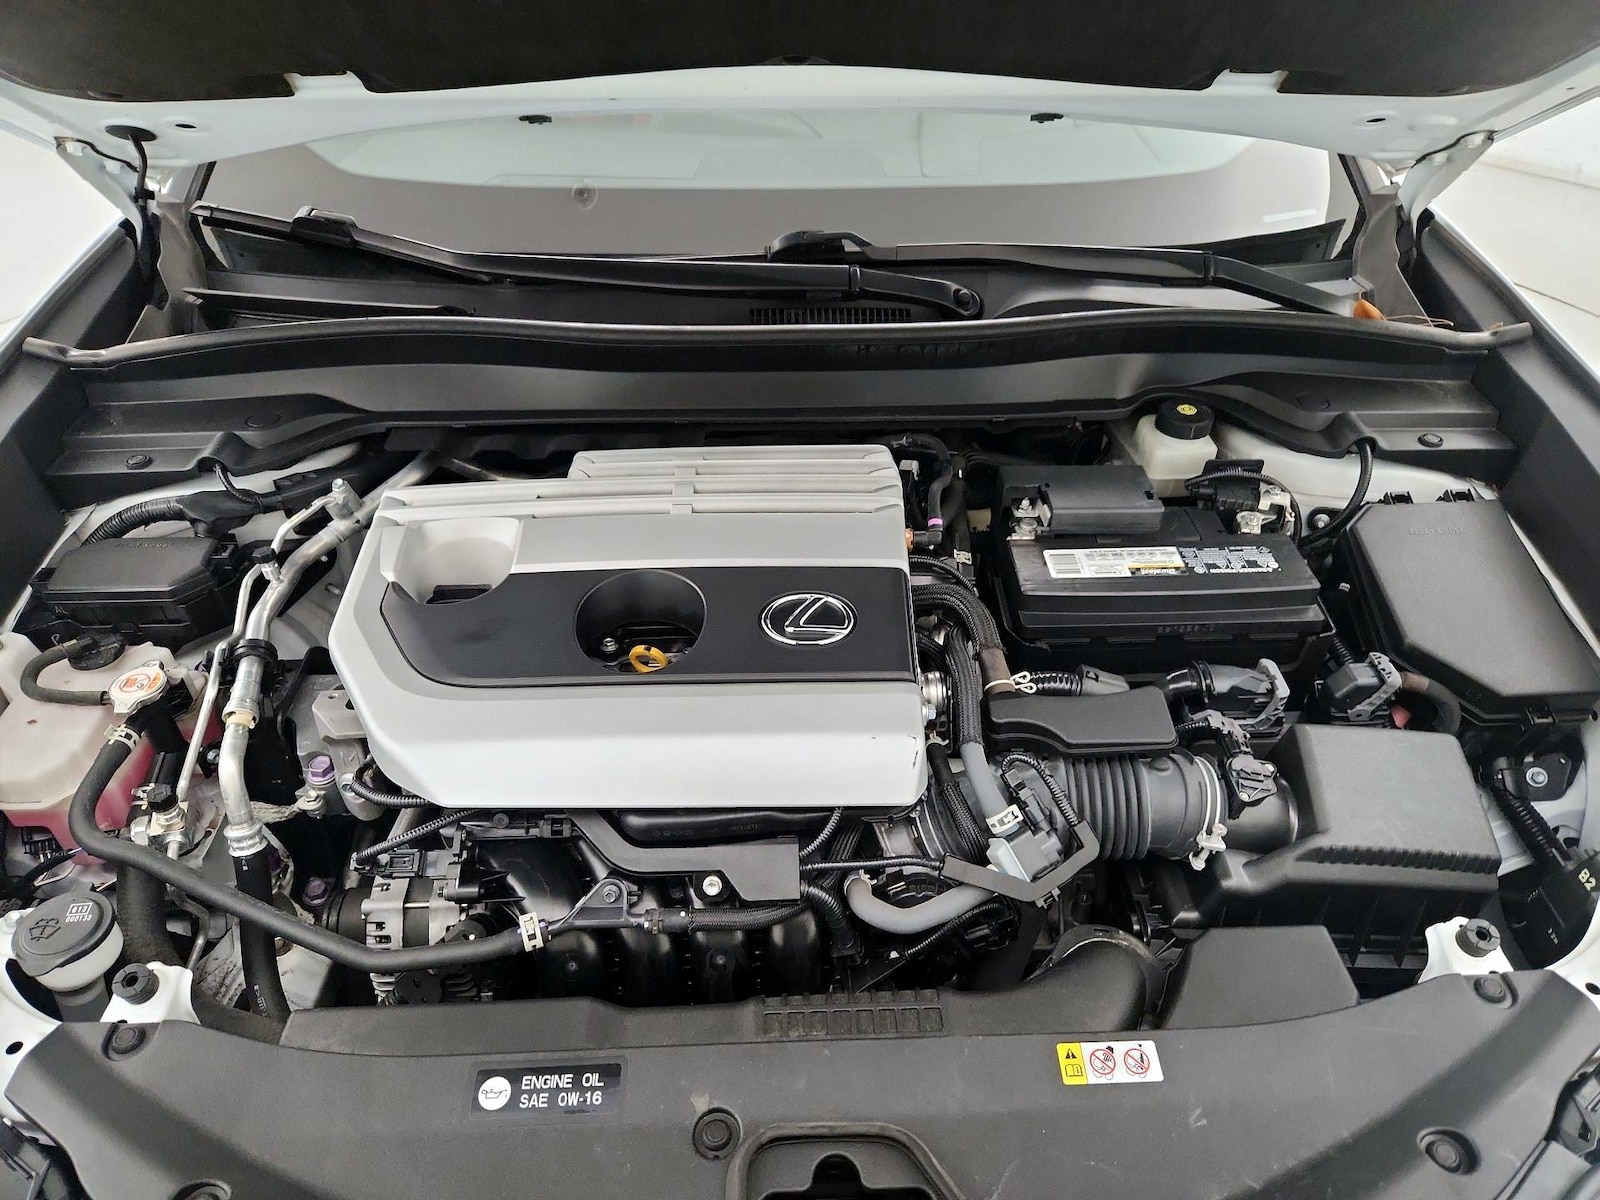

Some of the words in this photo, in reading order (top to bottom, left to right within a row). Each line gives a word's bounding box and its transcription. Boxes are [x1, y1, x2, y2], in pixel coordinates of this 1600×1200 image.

[1578, 867, 1597, 891] B2
[521, 1073, 574, 1090] ENGINE
[582, 1072, 604, 1087] OIL
[519, 1092, 549, 1109] SAE
[558, 1090, 603, 1107] 0W-16
